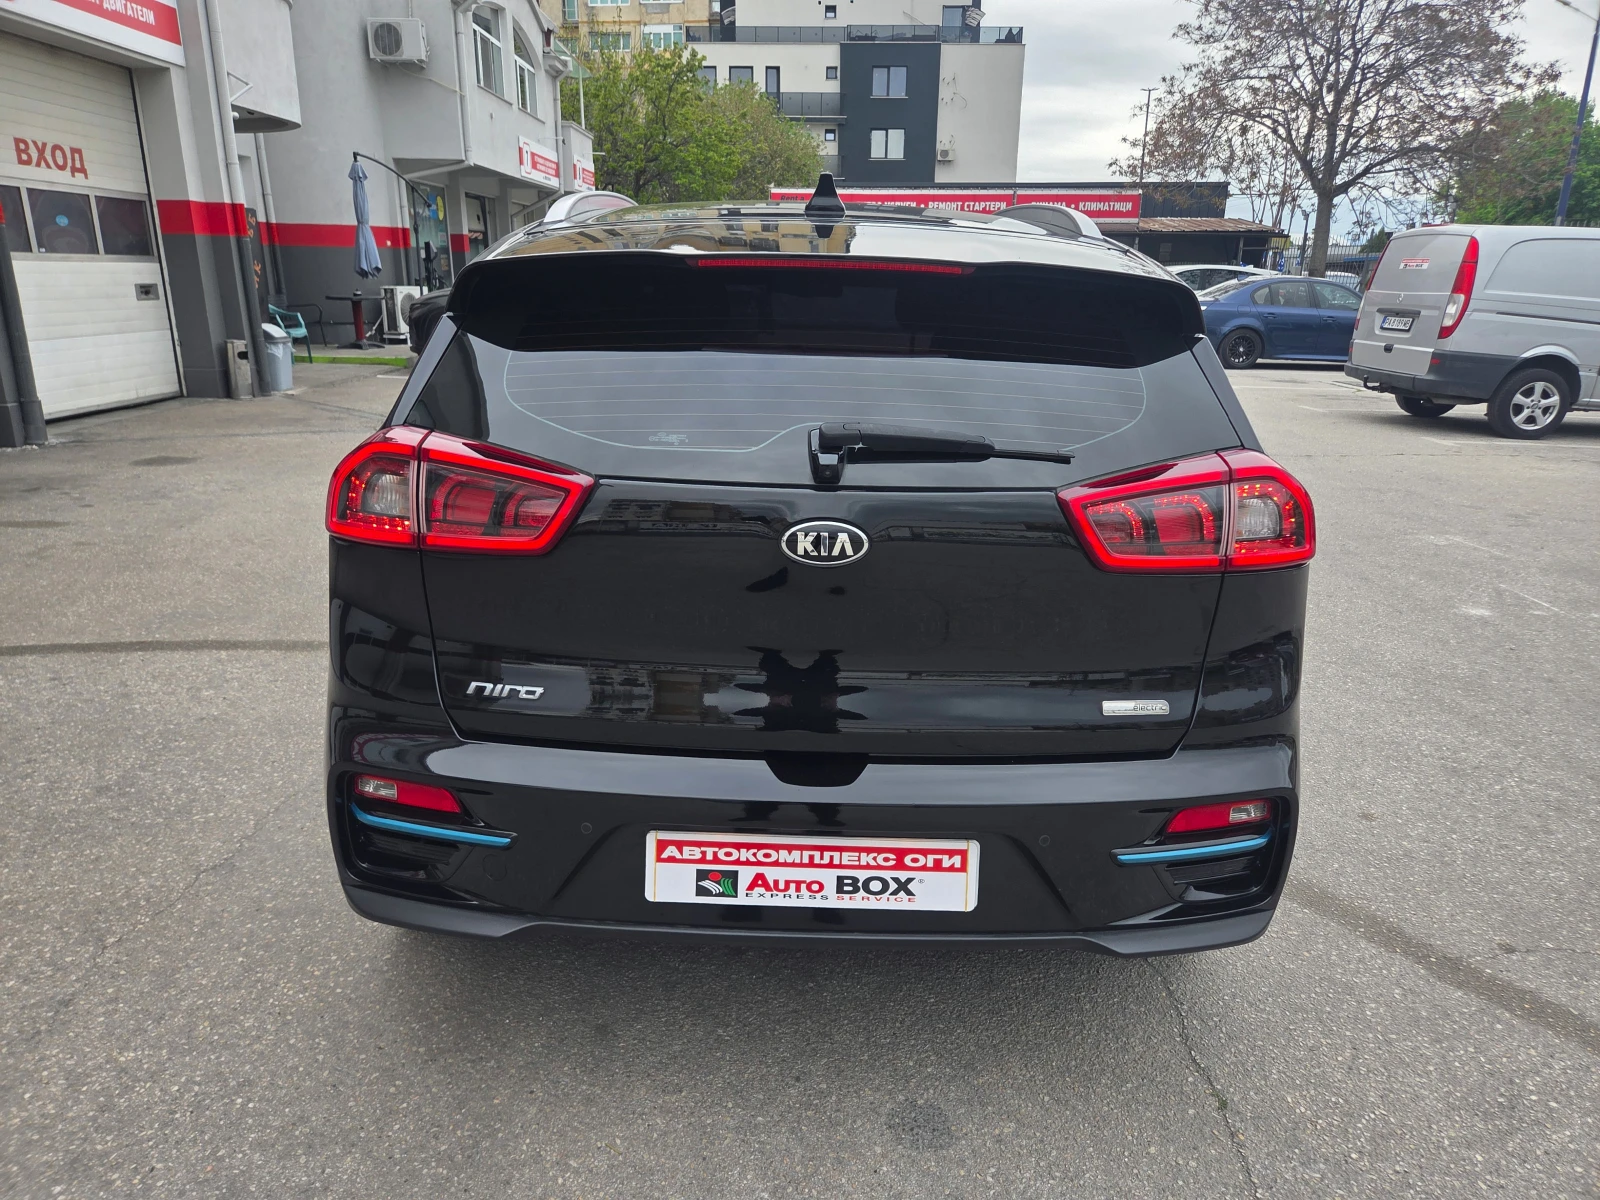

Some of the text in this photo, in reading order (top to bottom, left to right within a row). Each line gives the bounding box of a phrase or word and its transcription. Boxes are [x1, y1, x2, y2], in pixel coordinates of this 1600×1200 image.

[103, 0, 155, 26] ДВИГАТЕЛИ
[13, 136, 89, 180] ВХОД
[928, 201, 963, 211] РЕМОНТ
[964, 201, 1007, 211] СТАРТЕРИ
[1078, 201, 1133, 213] КЛИМАТИЦИ
[796, 531, 855, 556] KIA
[660, 845, 962, 868] АВТОКОМПЛЕКС ОГИ
[745, 892, 917, 903] EXPRESS SERVICE
